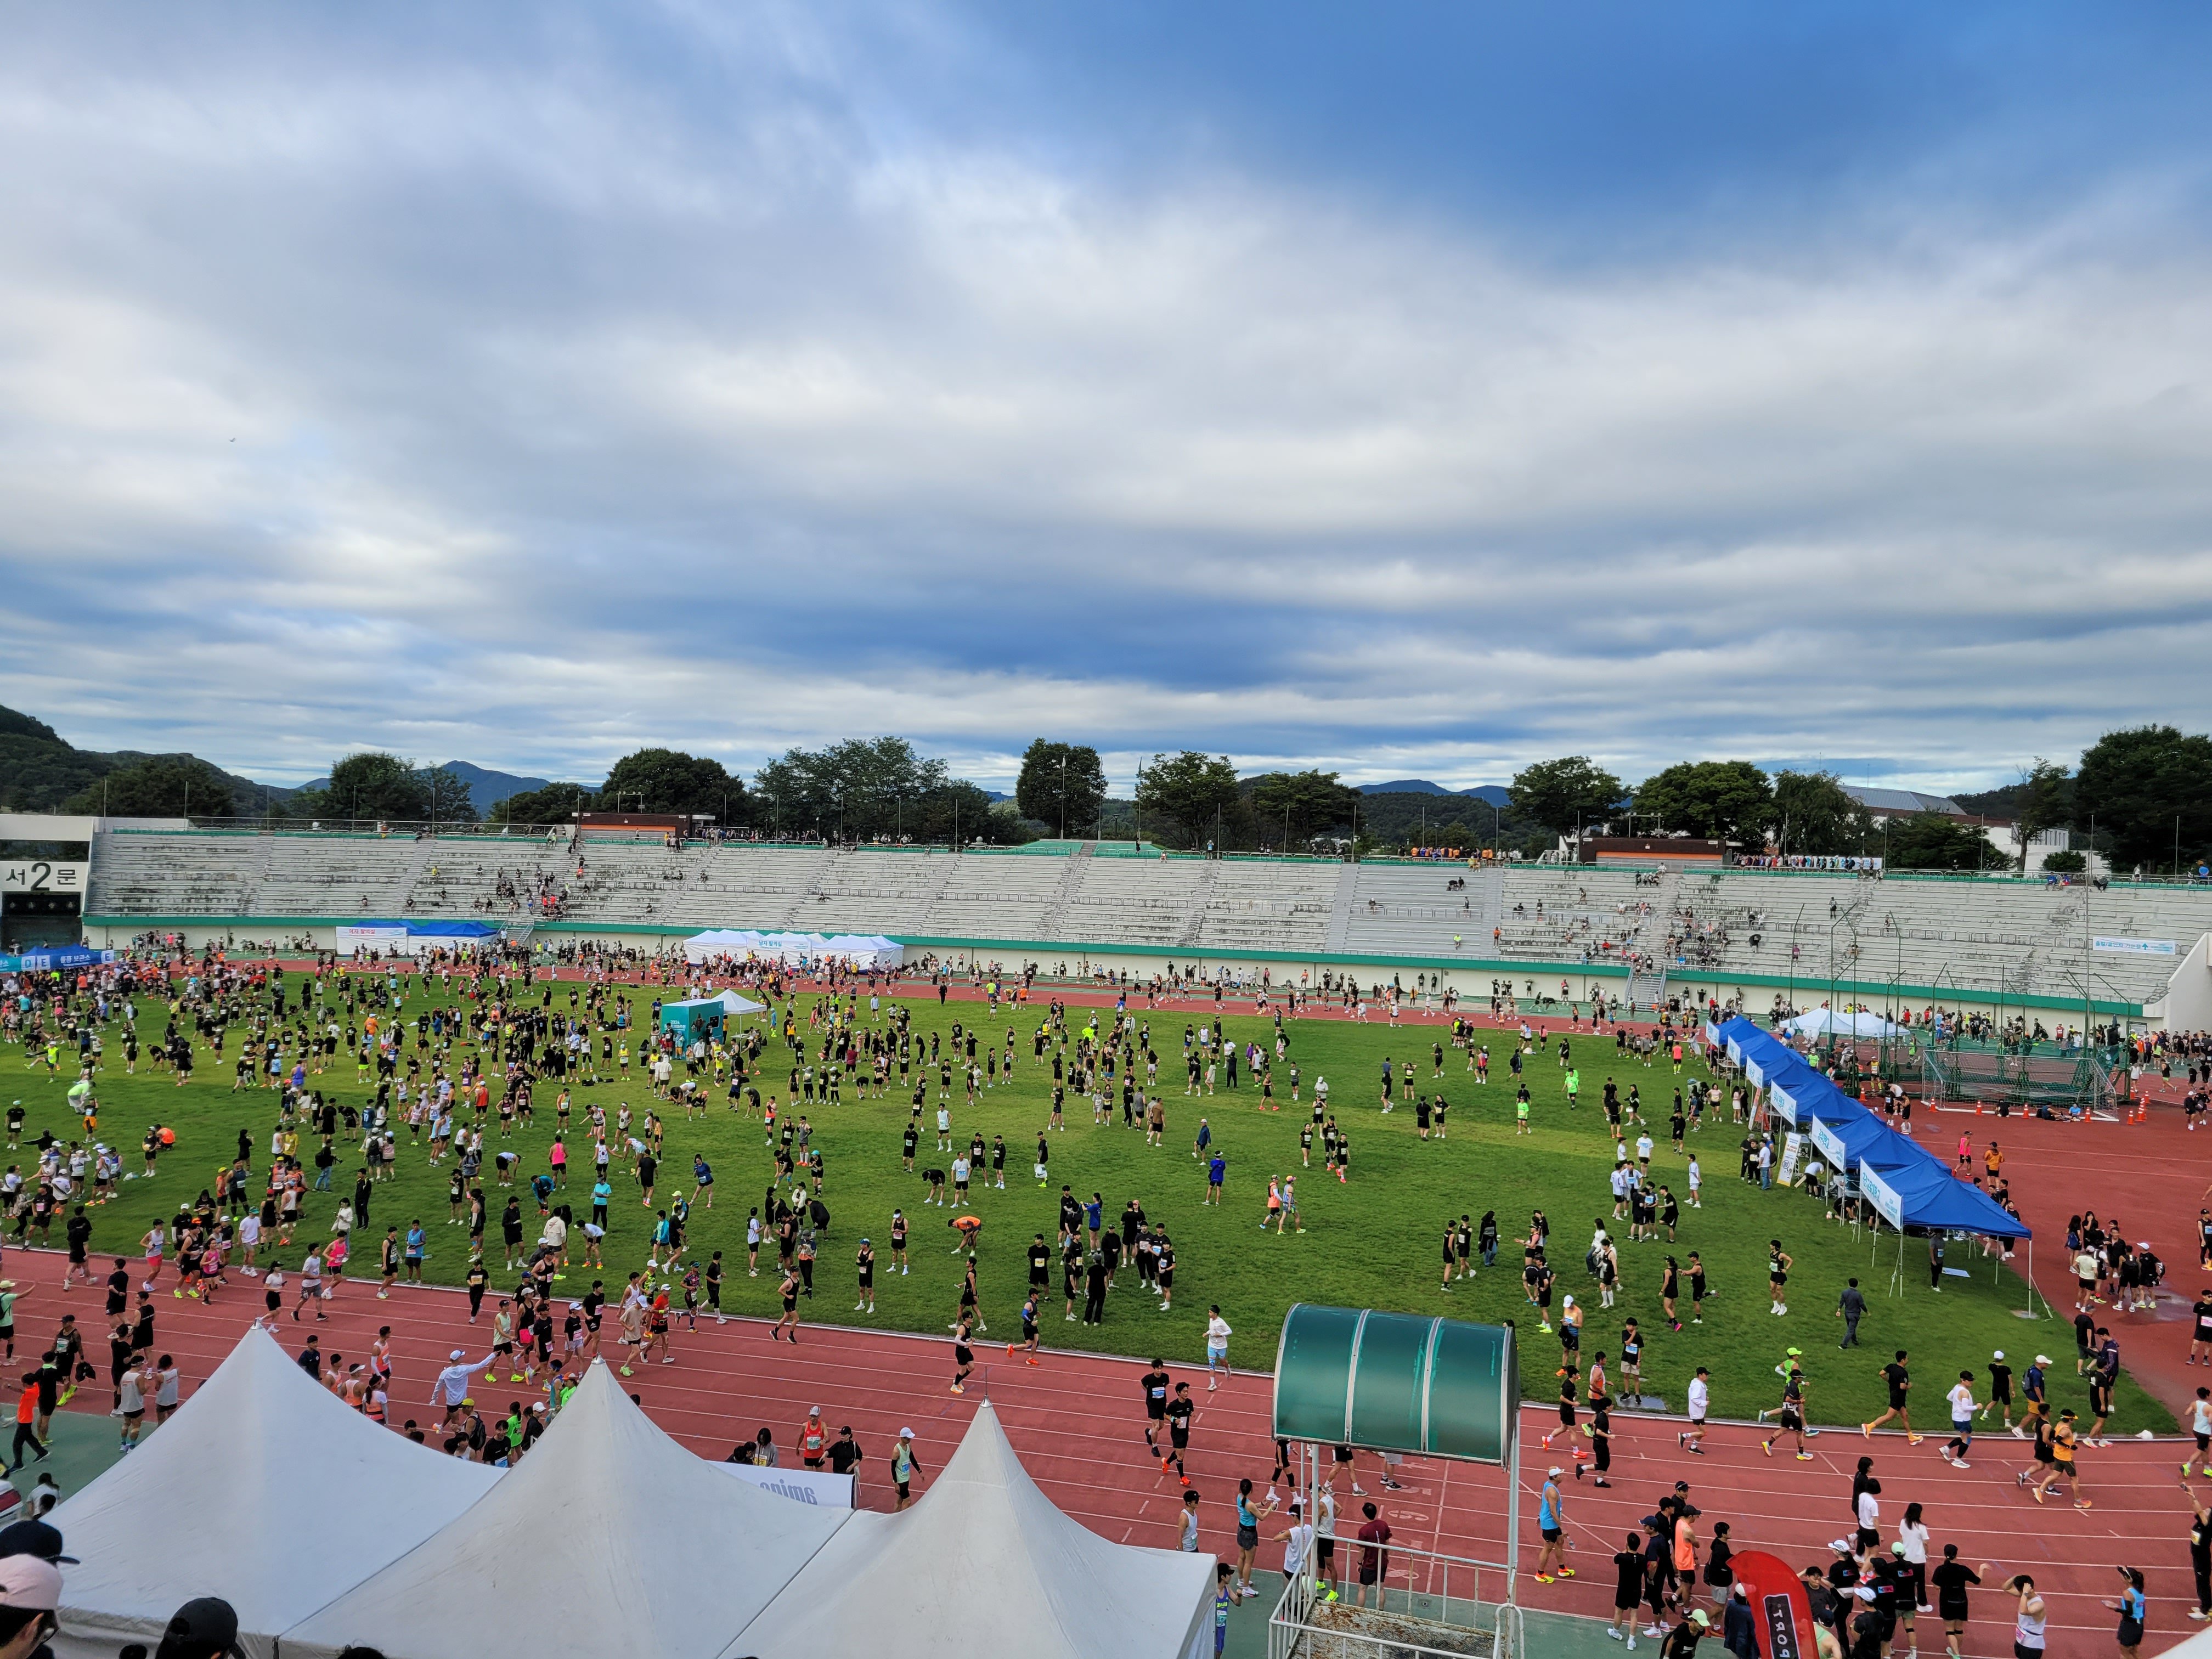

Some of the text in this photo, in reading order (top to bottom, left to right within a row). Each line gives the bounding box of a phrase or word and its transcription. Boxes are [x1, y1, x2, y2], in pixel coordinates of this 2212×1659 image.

[104, 953, 110, 961] E
[25, 959, 31, 968] D
[41, 958, 47, 967] E
[1387, 1510, 1429, 1521] 6
